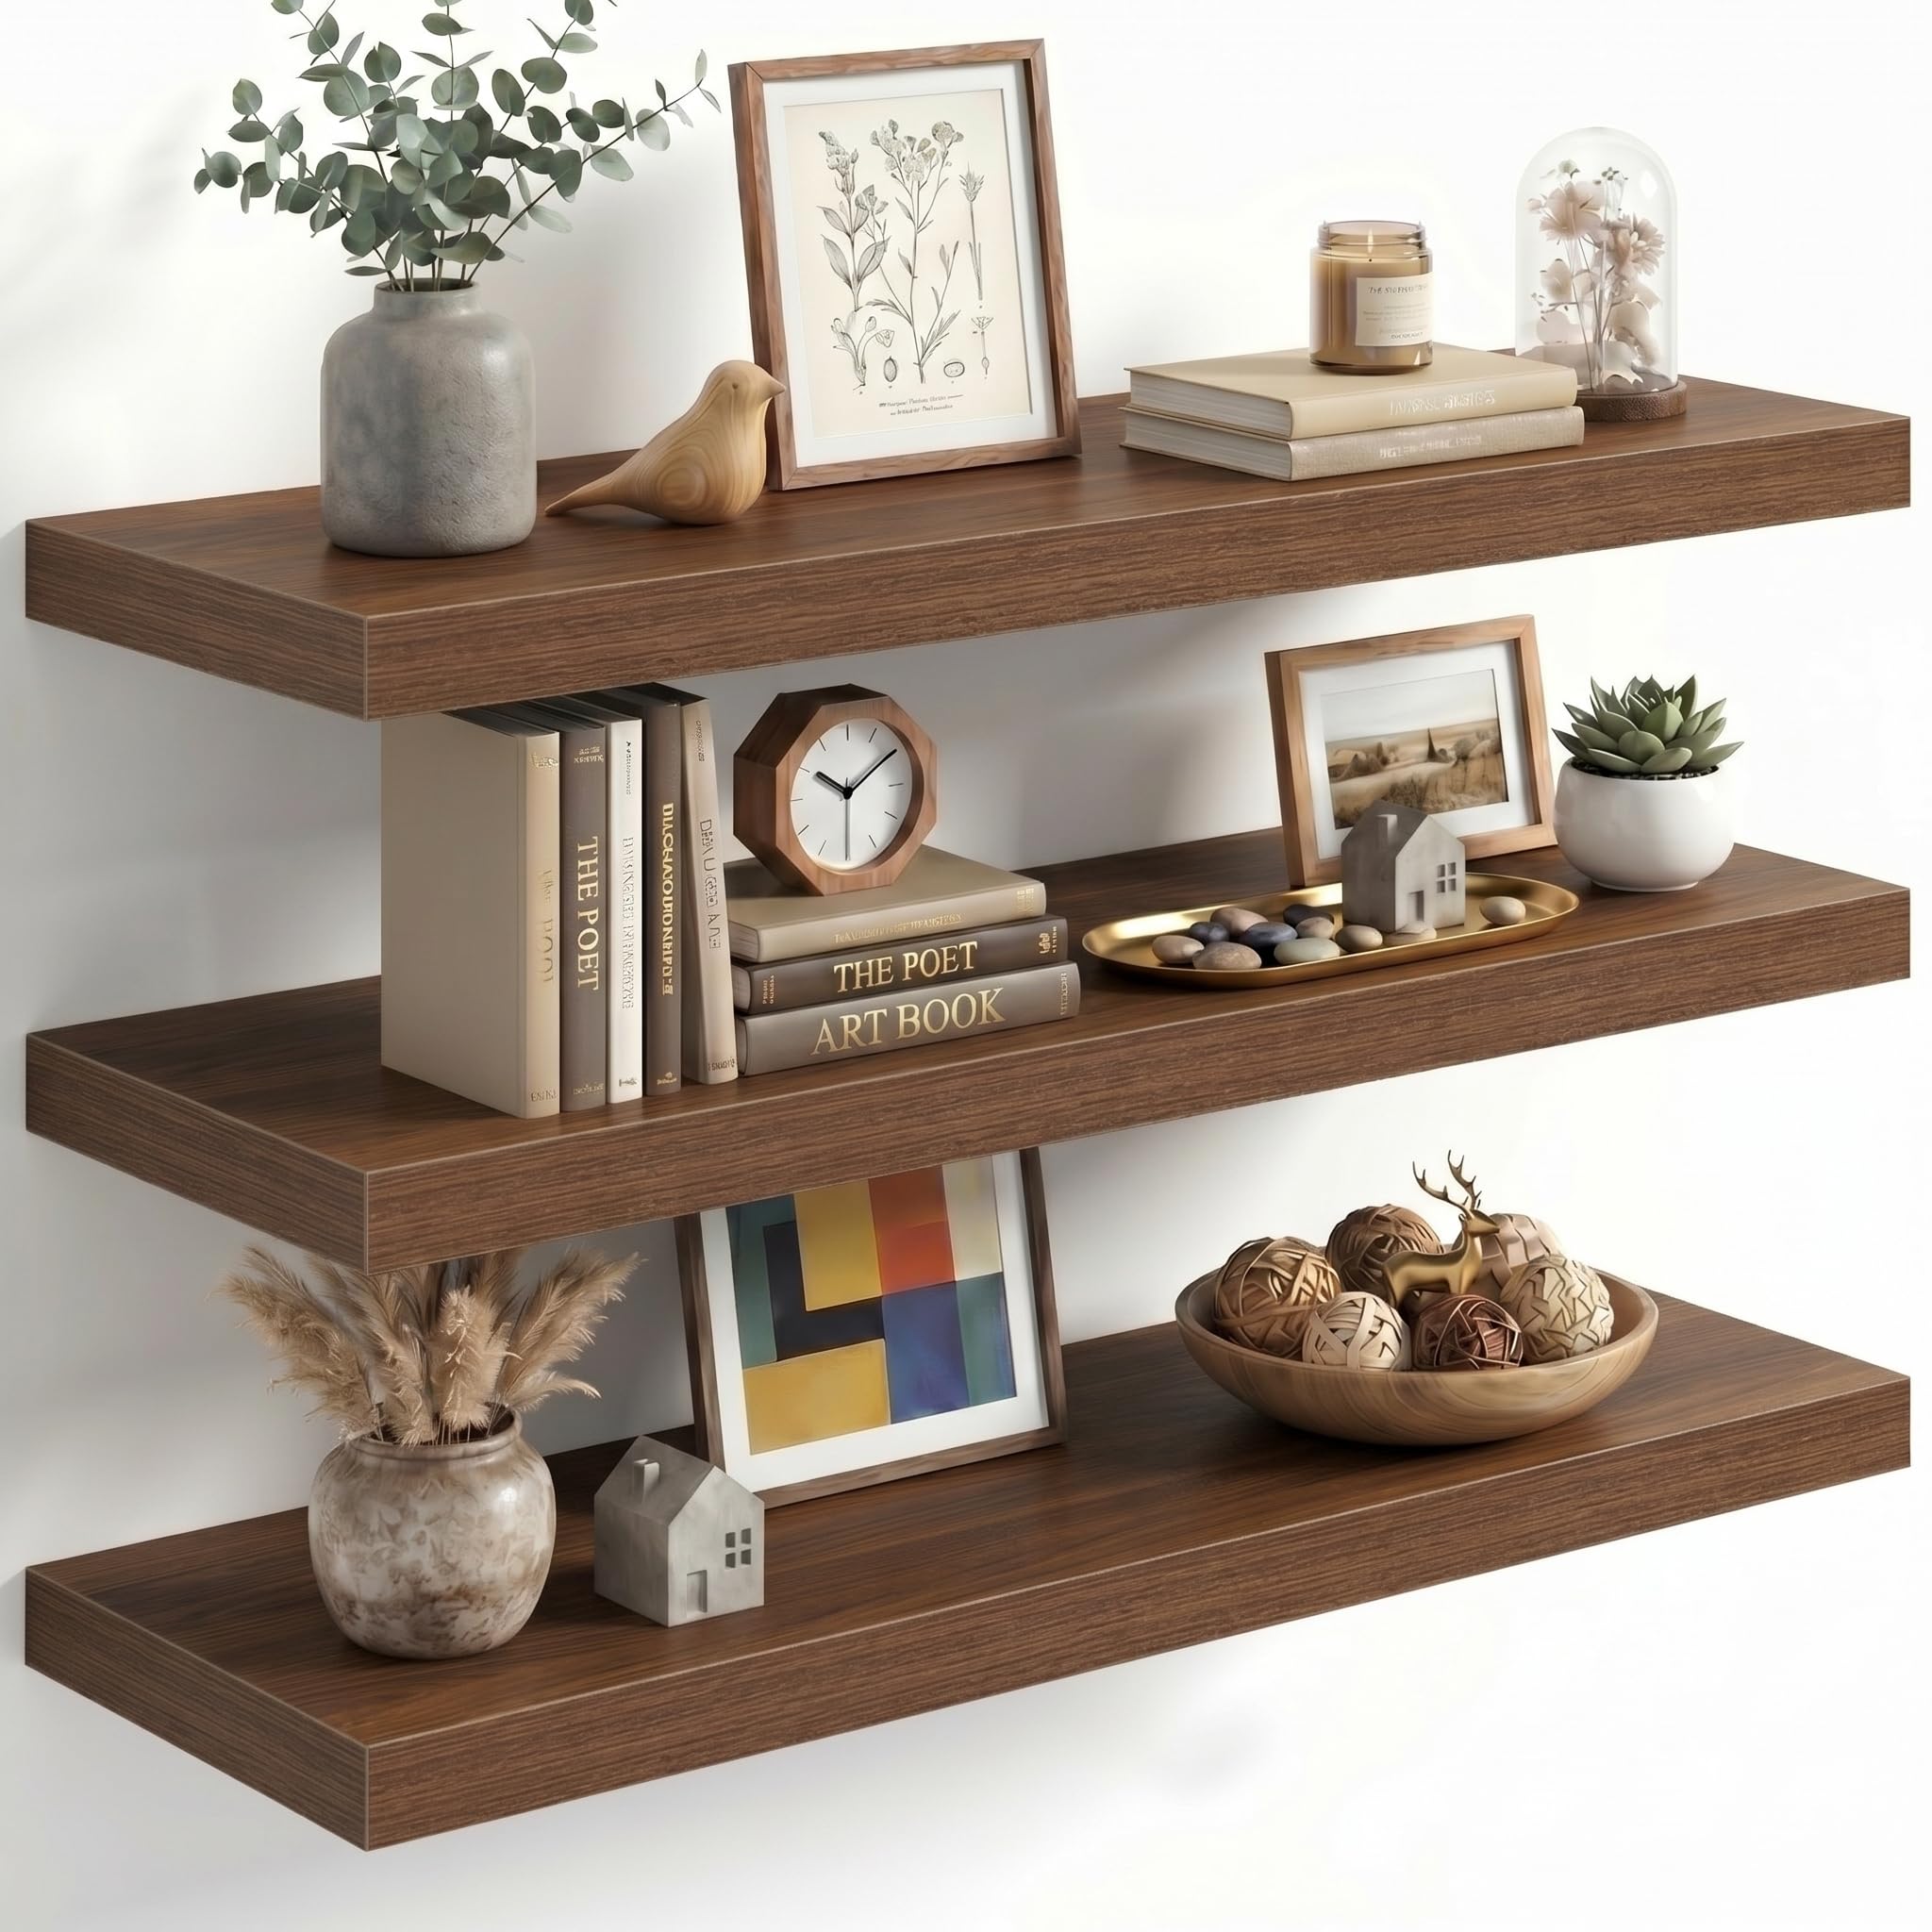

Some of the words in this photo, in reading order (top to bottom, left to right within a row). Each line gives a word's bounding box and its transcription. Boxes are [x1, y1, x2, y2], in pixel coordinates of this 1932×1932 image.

[577, 837, 599, 901] THE
[577, 908, 599, 991] POET
[833, 956, 894, 993] THE
[902, 941, 978, 981] POET
[809, 1008, 890, 1056] ART
[895, 987, 1007, 1040] BOOK
